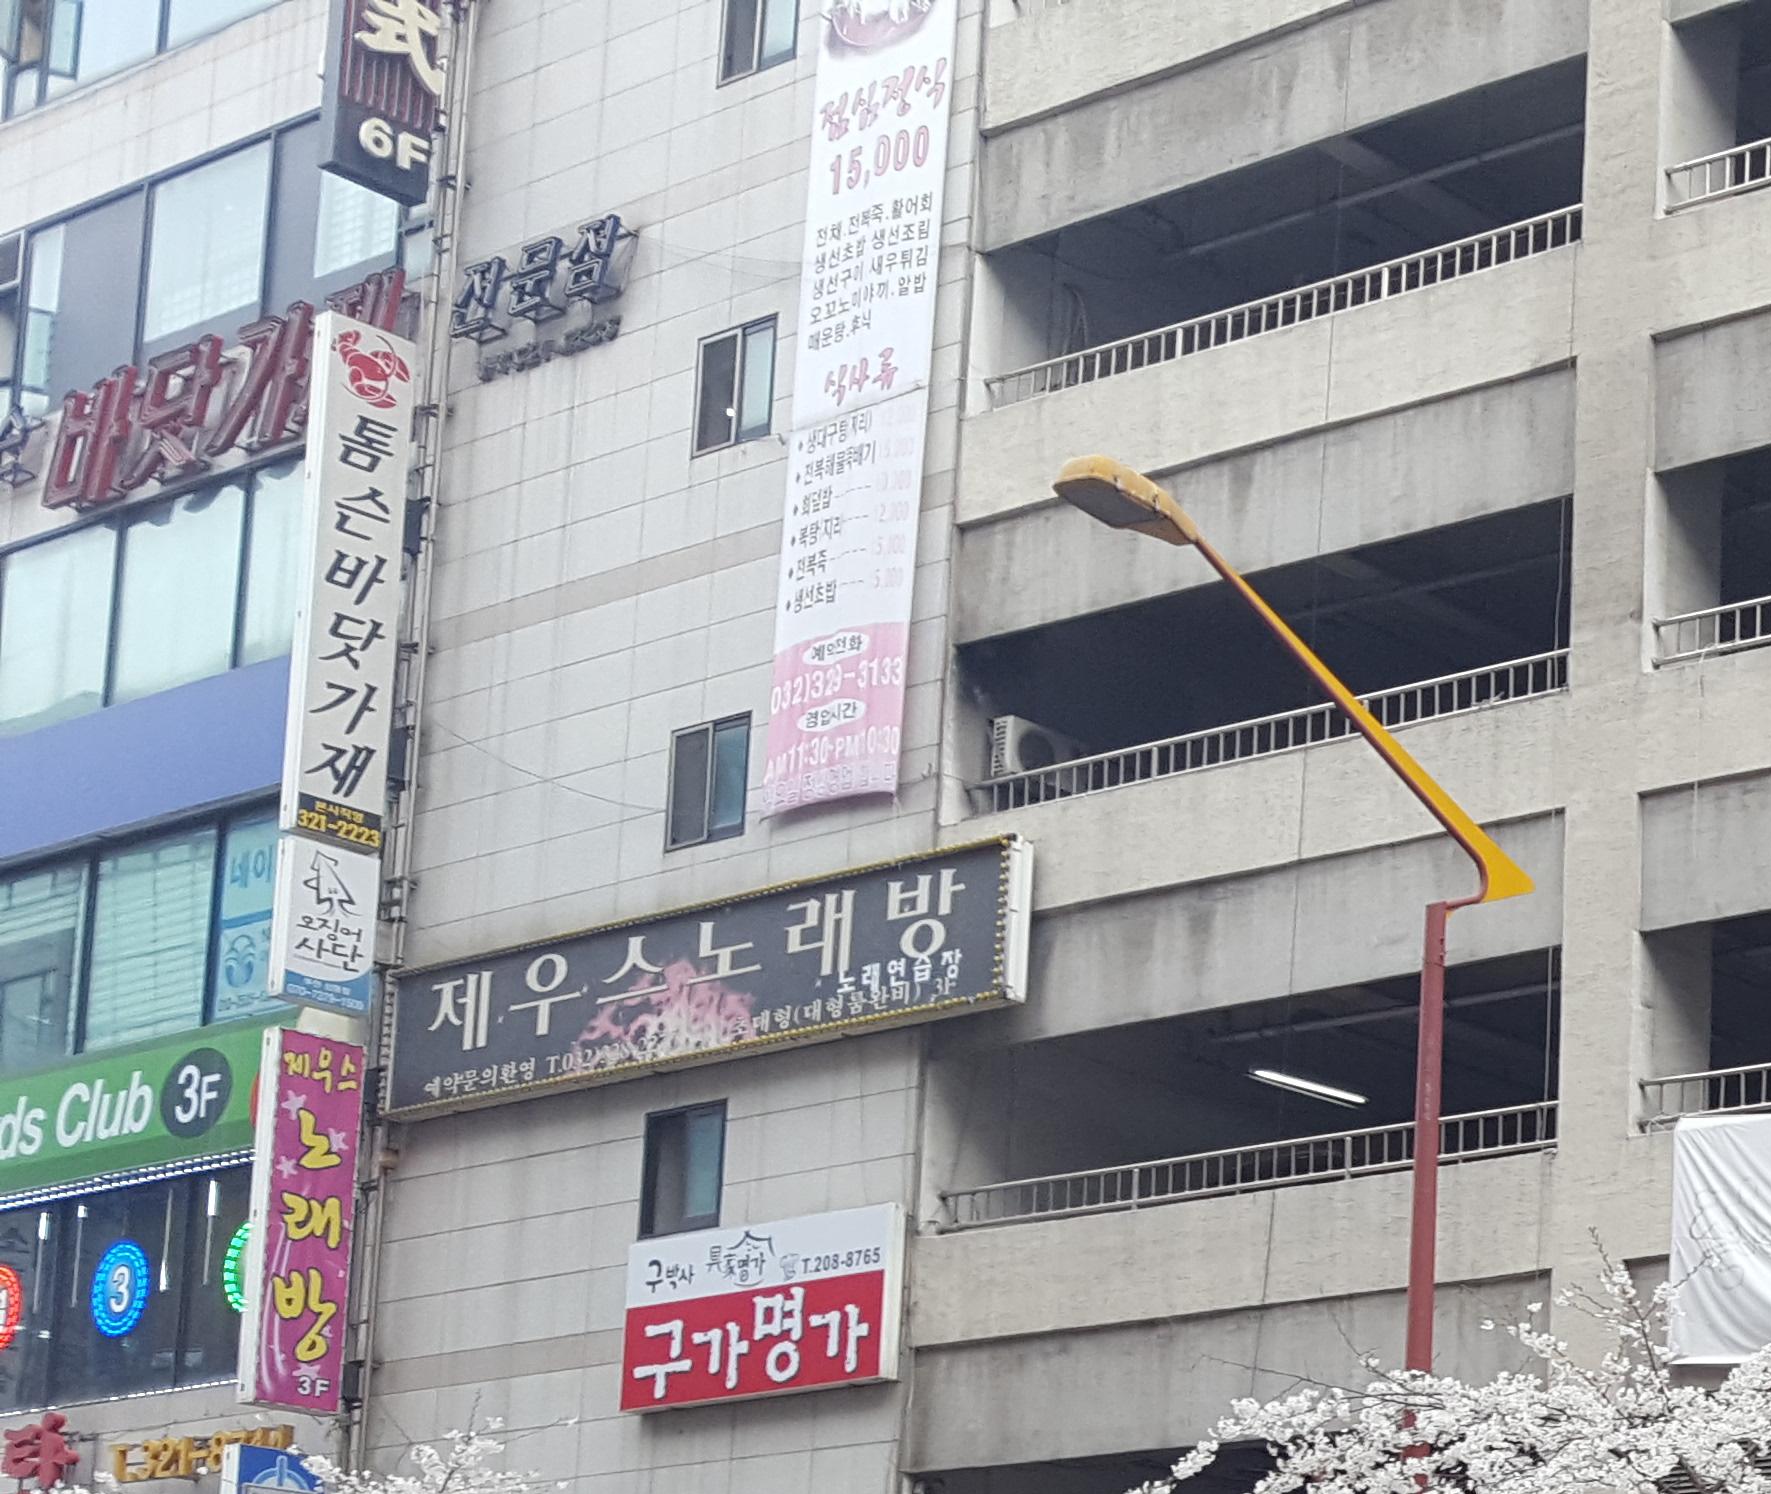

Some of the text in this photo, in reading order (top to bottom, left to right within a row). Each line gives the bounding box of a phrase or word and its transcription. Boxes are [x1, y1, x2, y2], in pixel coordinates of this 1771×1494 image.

[820, 57, 947, 142] 점심정식
[359, 117, 428, 171] 6F
[829, 125, 930, 194] 15,000
[872, 219, 930, 250] 생선조림
[449, 213, 624, 338] 전문점
[824, 347, 899, 406] 식사류
[304, 414, 399, 798] 톰슨바닷가재
[298, 809, 381, 848] 321-2223
[294, 937, 364, 973] 사단
[296, 915, 363, 942] 오징어
[836, 948, 962, 994] 노래연습장
[284, 1047, 358, 1093] 제우스
[56, 1071, 153, 1147] Club
[175, 1065, 221, 1123] 3F
[272, 1109, 341, 1361] 노래방
[110, 1265, 129, 1313] 3
[632, 1286, 870, 1400] 구가명가
[296, 1376, 330, 1396] 3F
